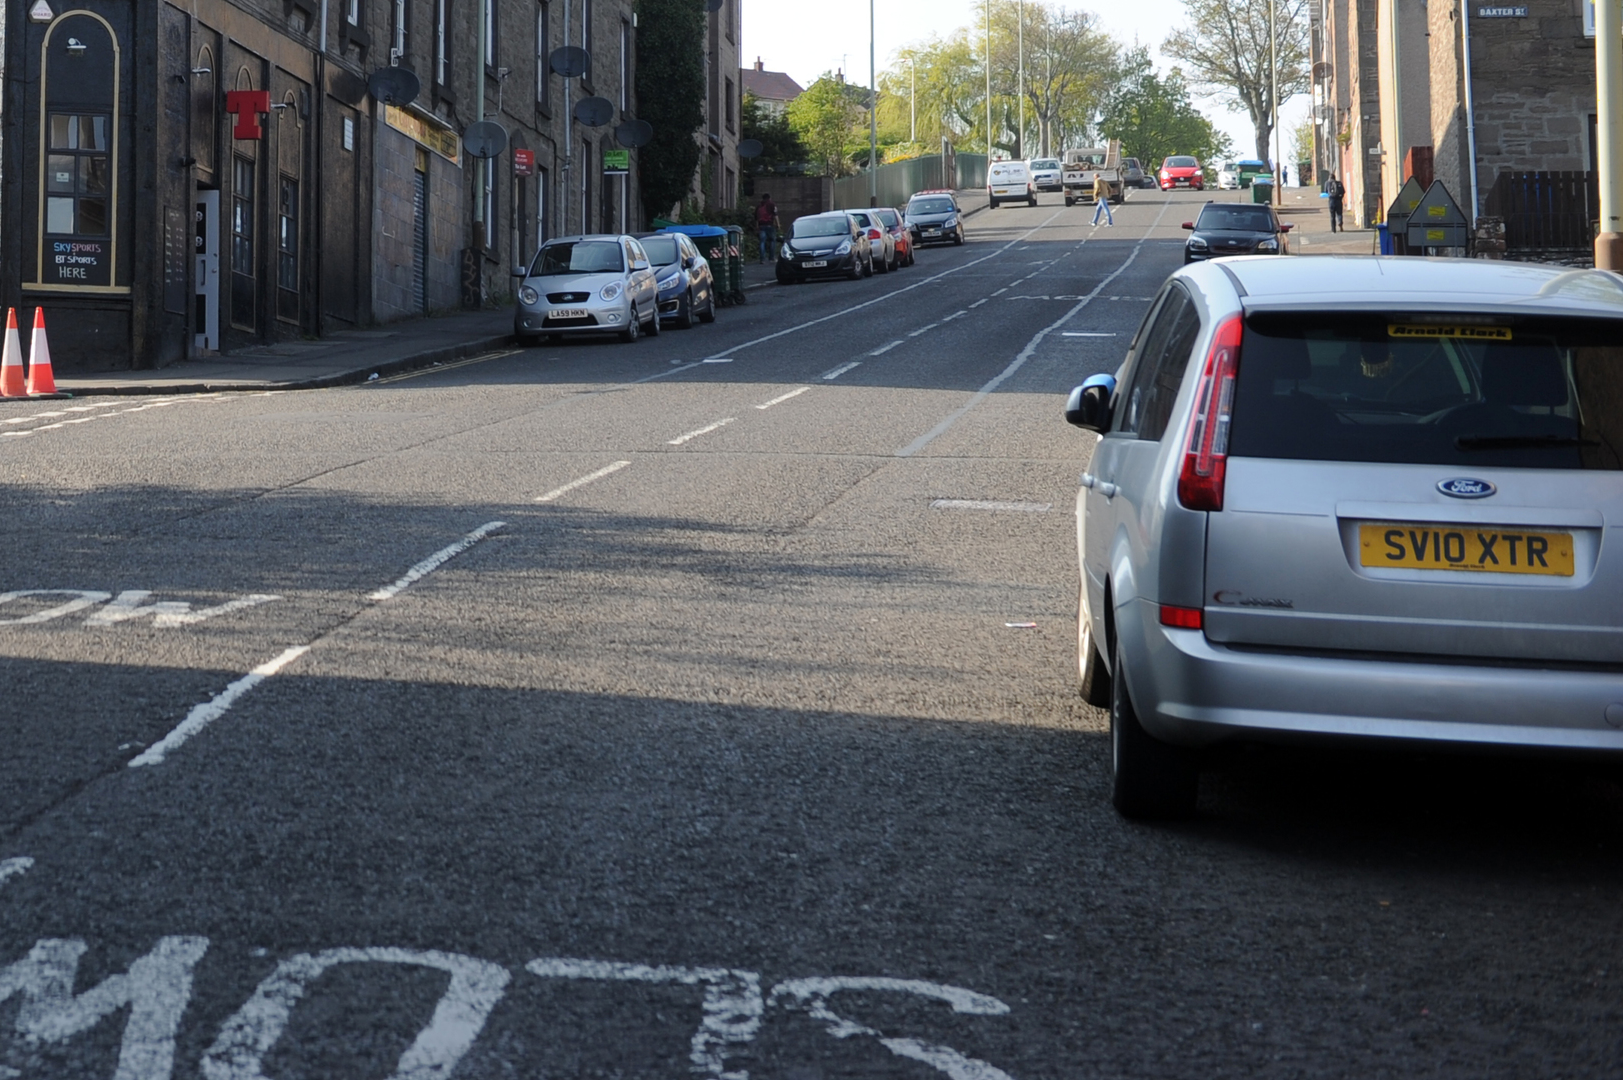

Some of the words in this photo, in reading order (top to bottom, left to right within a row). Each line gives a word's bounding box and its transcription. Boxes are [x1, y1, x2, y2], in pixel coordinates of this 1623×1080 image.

[1479, 8, 1513, 16] BAXTER
[53, 242, 71, 253] SKY
[71, 243, 102, 253] SPORTS
[55, 254, 66, 264] BT
[67, 255, 98, 265] SPORTS
[59, 265, 87, 279] HERE
[551, 309, 570, 318] LA59
[1393, 326, 1456, 336] Arnold
[1460, 327, 1507, 338] Clark
[1450, 479, 1483, 494] Ford
[1384, 529, 1466, 564] SV10
[1477, 533, 1549, 569] XTR
